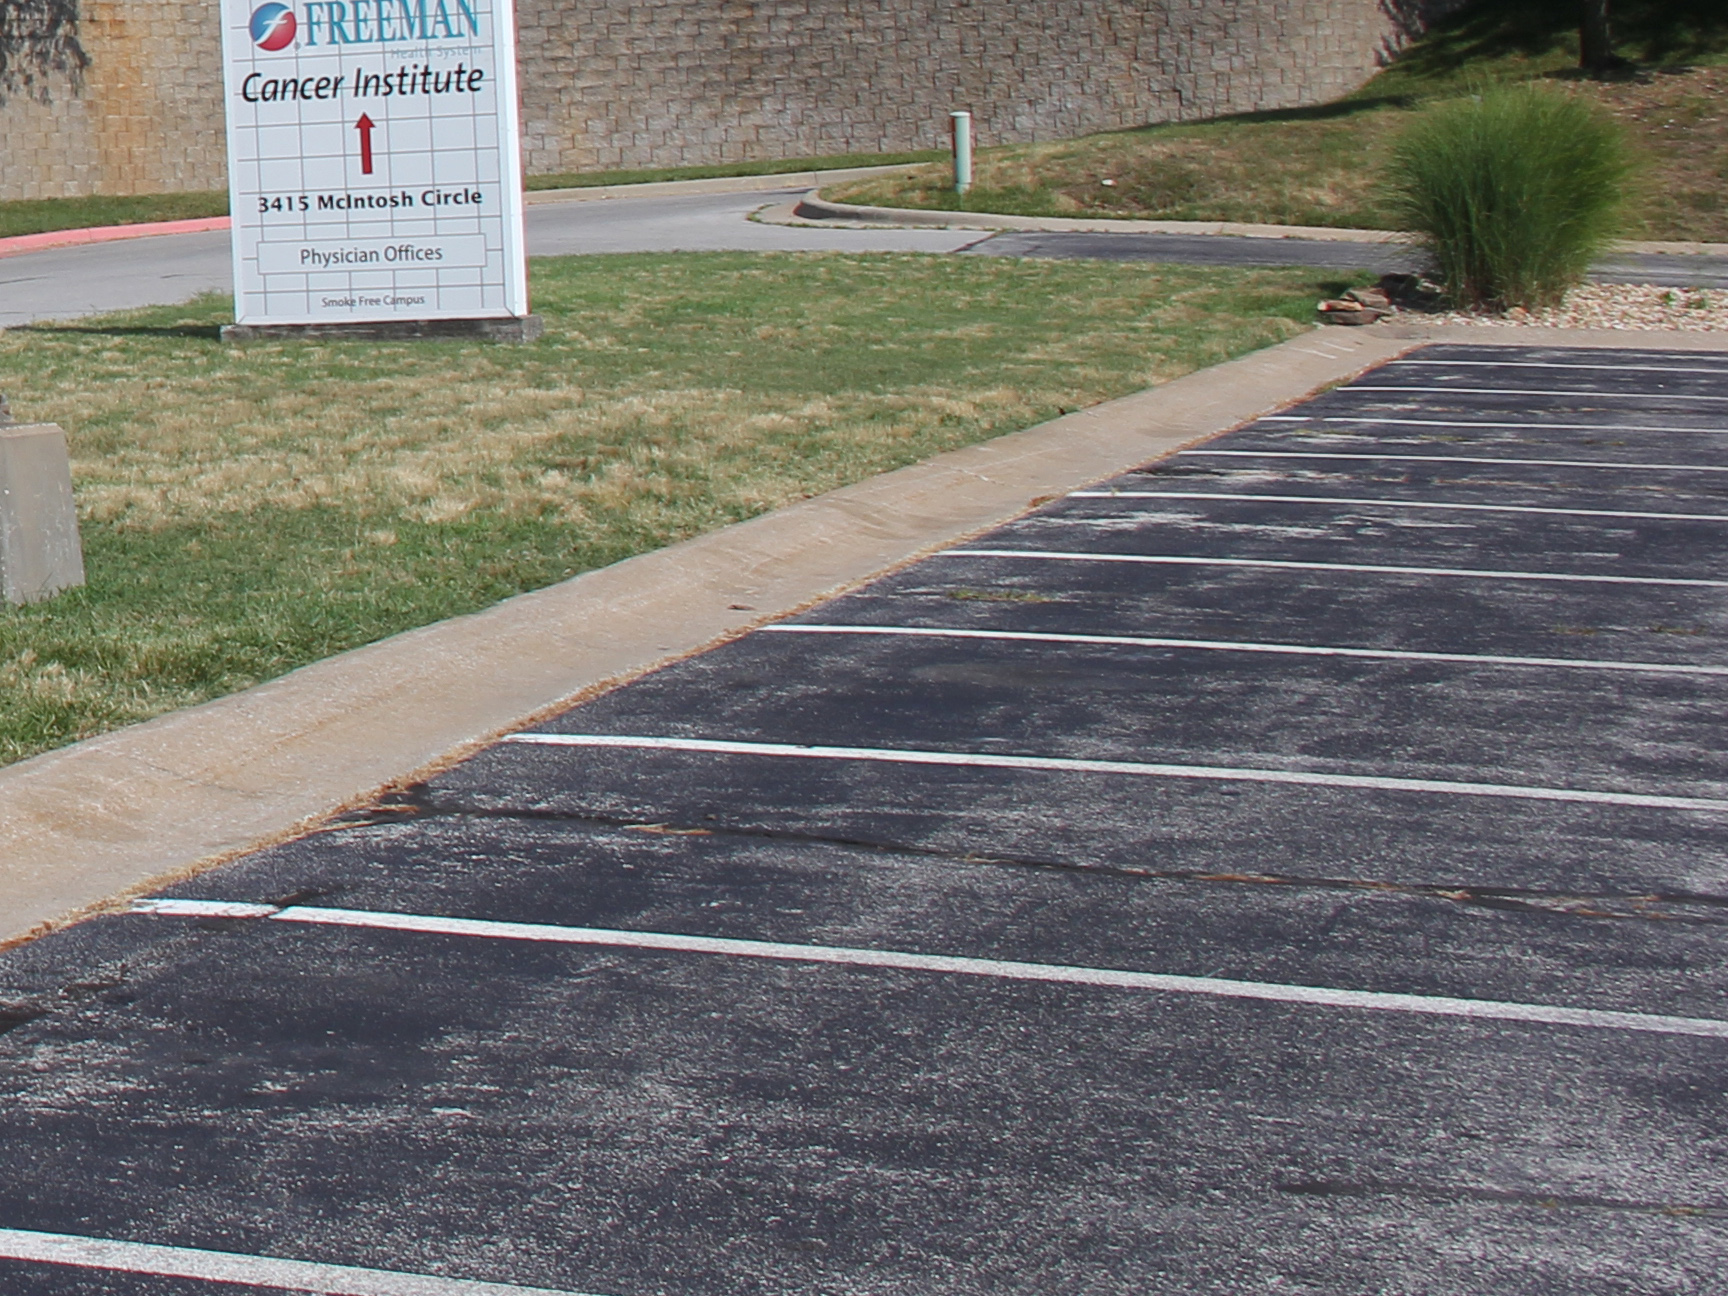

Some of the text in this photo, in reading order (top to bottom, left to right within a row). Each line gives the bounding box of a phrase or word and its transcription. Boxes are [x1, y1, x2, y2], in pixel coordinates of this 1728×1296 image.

[390, 44, 481, 61] Health System
[242, 62, 484, 102] Cancer Institute
[258, 188, 483, 213] 3415 McIntosh Circle
[300, 245, 443, 268] Physician Offices
[321, 294, 425, 309] Smoke Free Campus
